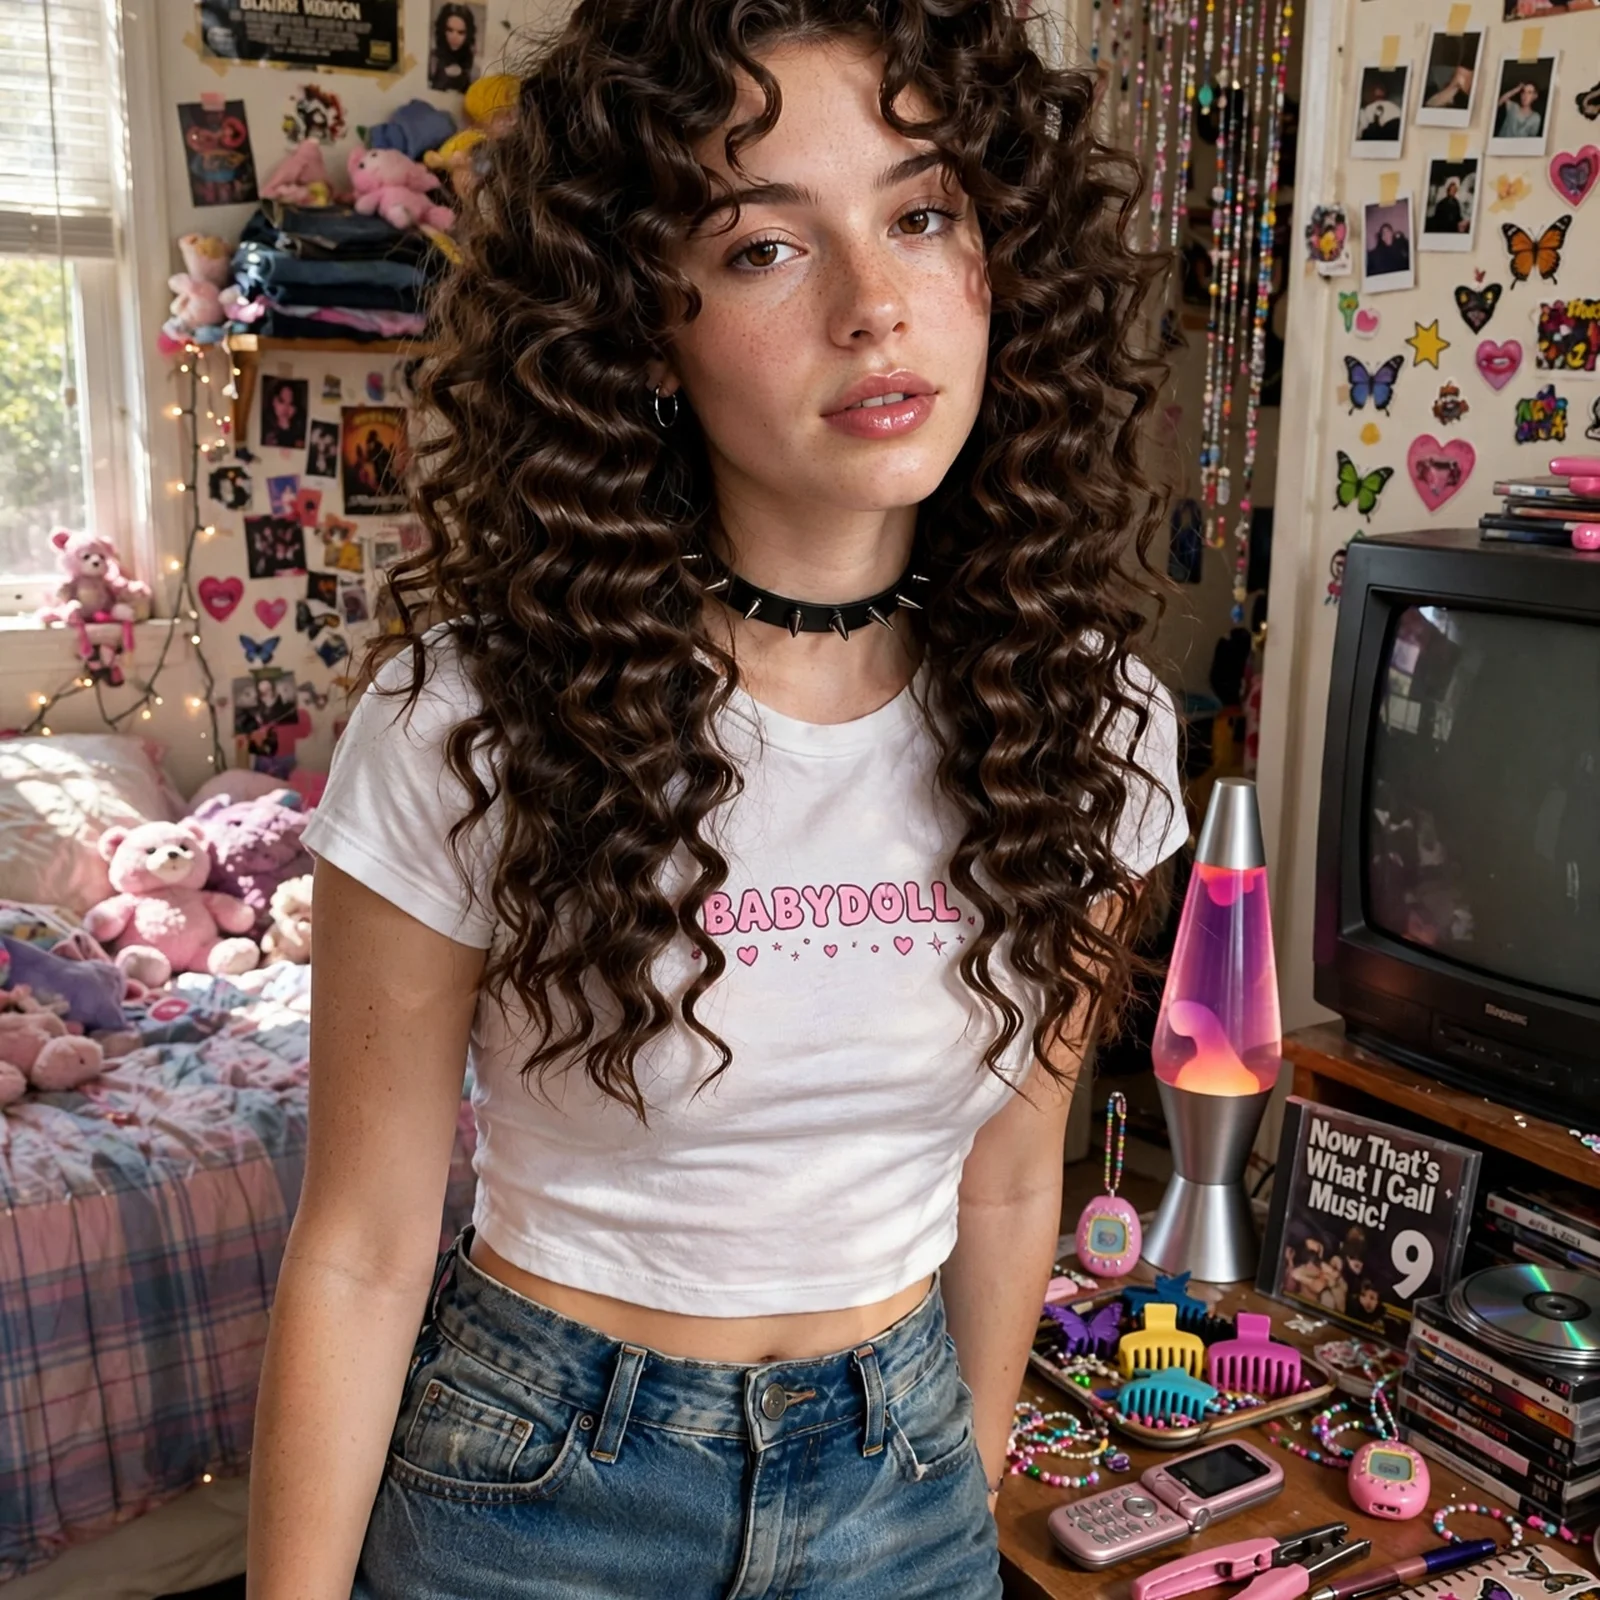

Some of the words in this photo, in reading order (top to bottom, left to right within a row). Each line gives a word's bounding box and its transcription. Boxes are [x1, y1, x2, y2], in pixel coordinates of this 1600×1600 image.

[702, 881, 961, 935] BABYDOLL
[1307, 1147, 1367, 1193] What
[1371, 1168, 1383, 1197] I
[1386, 1173, 1436, 1214] Call
[1309, 1118, 1362, 1158] Now
[1367, 1134, 1440, 1183] That's
[1308, 1180, 1390, 1231] Music!
[1391, 1229, 1434, 1300] 9
